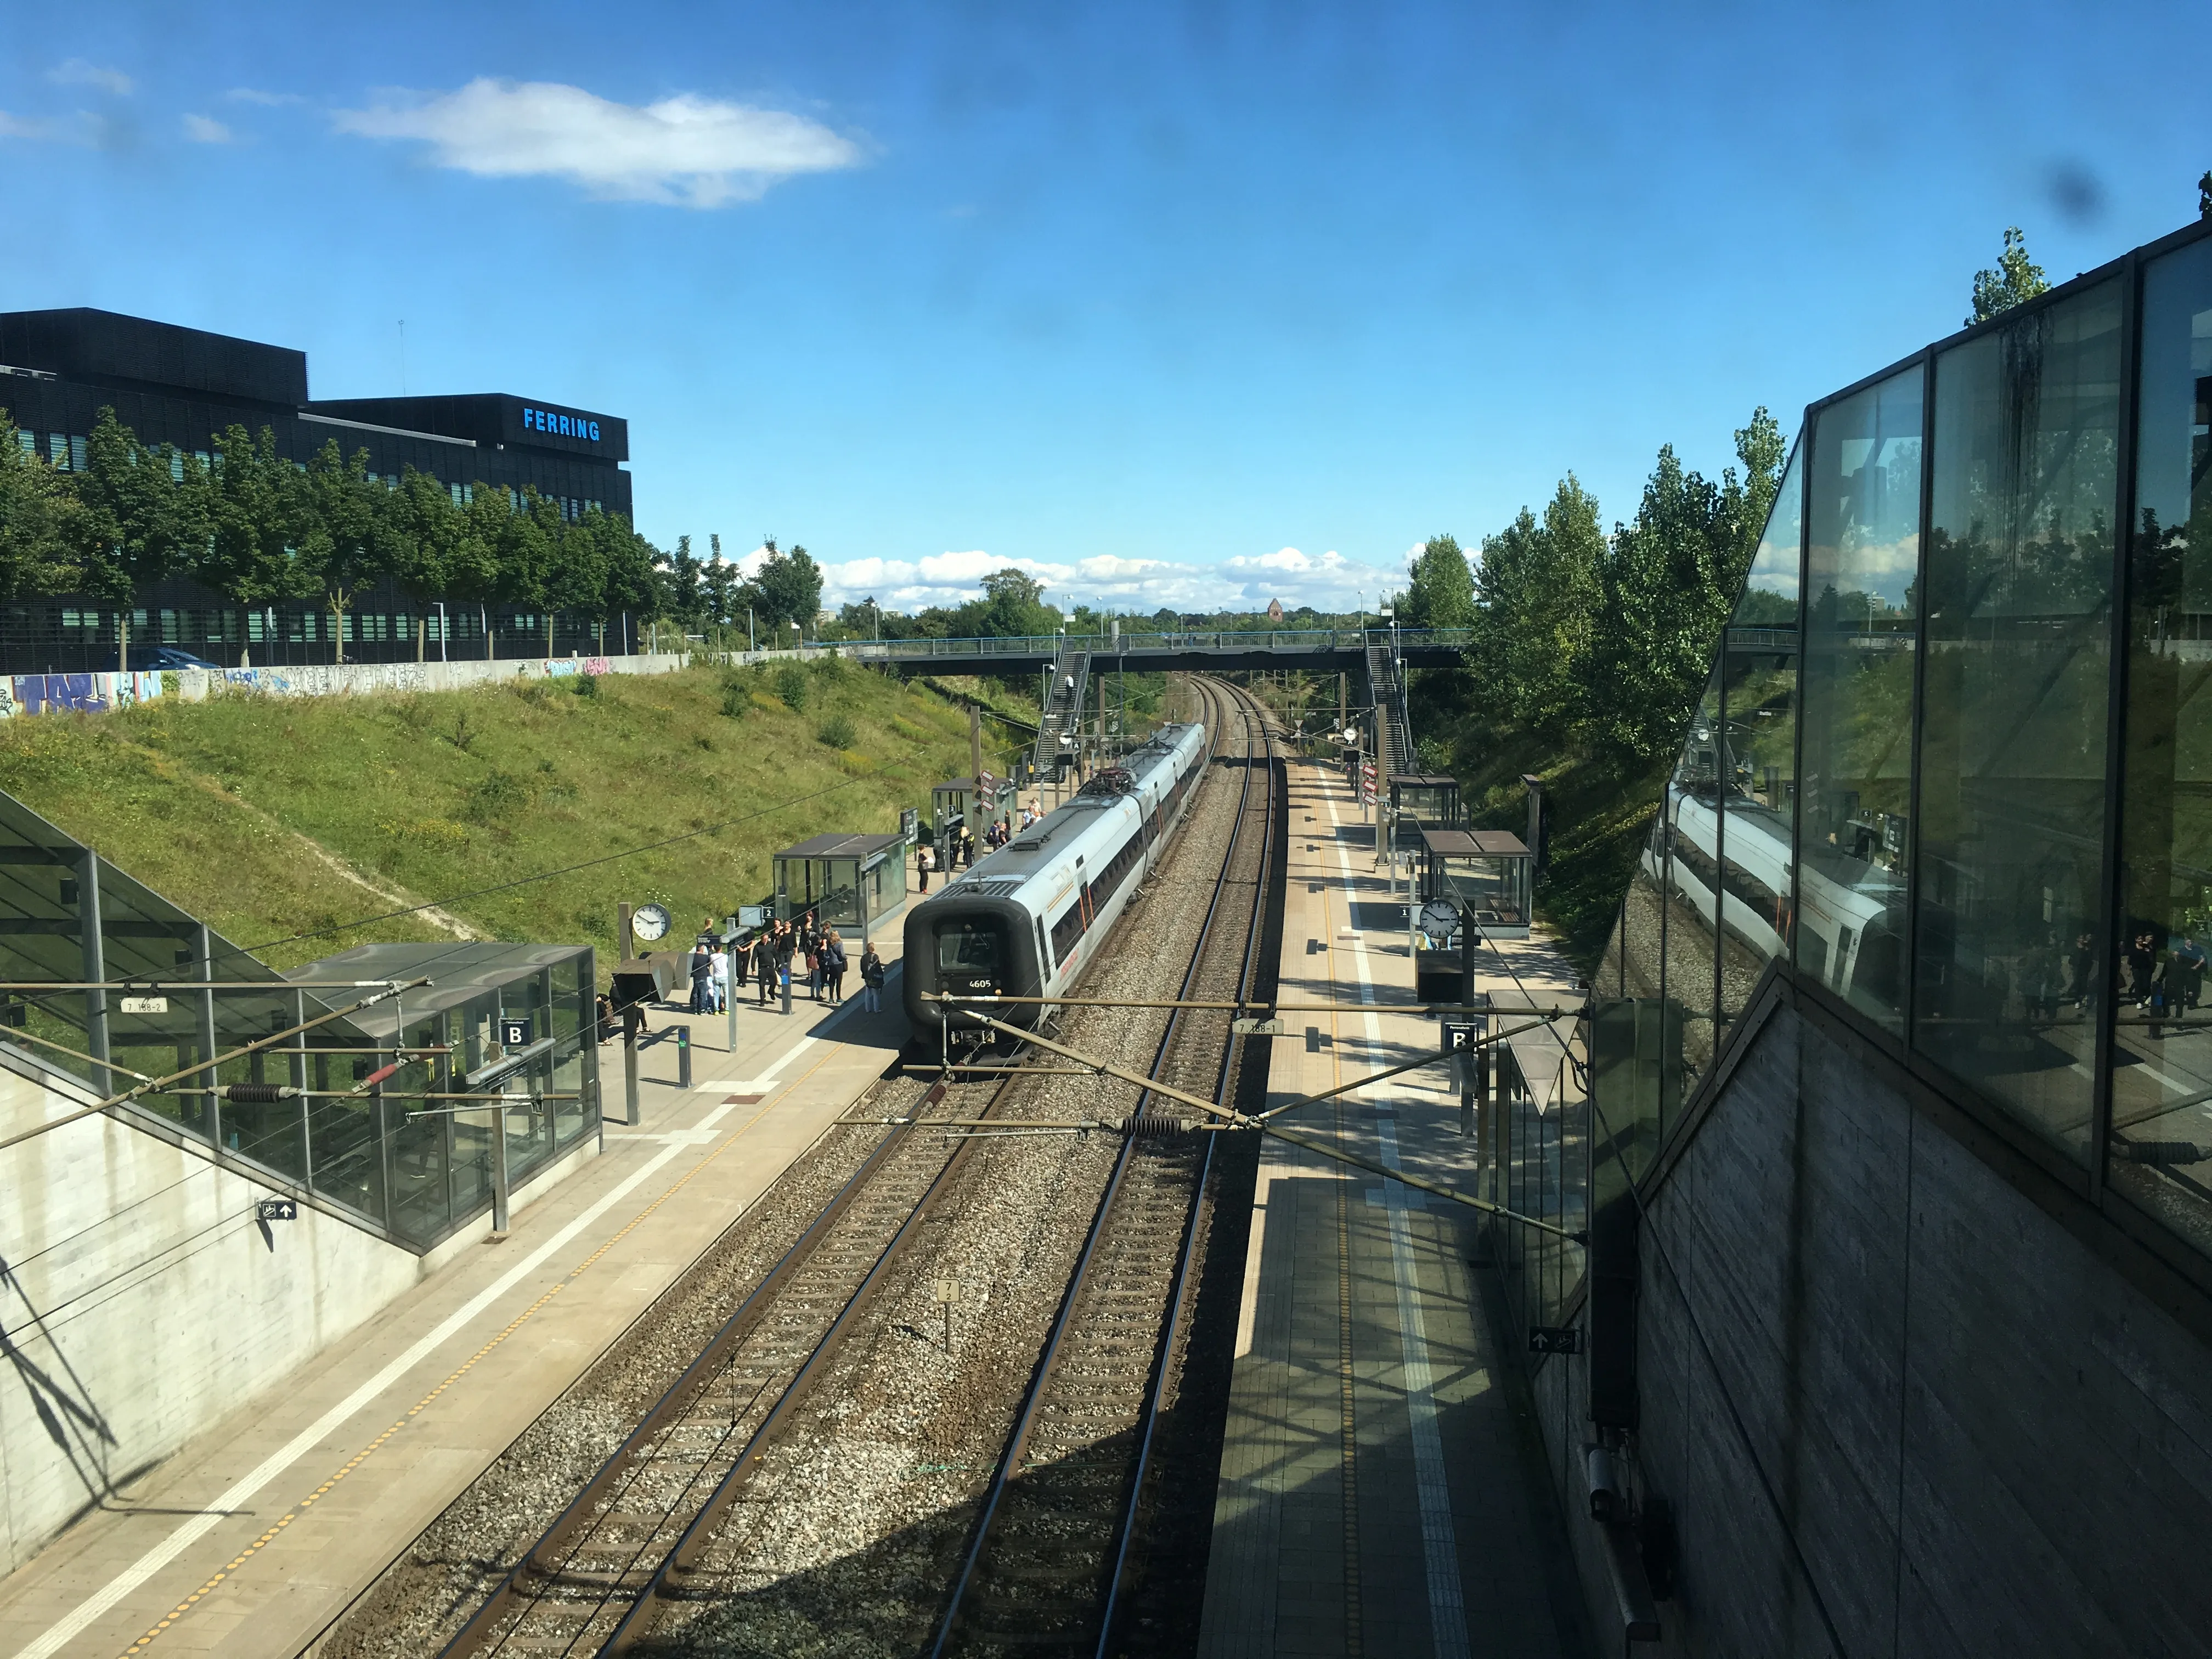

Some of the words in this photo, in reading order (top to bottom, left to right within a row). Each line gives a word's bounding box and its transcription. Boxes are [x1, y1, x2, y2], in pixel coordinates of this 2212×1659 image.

[524, 408, 600, 441] FERRING
[969, 980, 991, 988] 4605
[509, 1027, 522, 1043] B
[1453, 1032, 1466, 1048] B
[945, 1282, 952, 1291] 7
